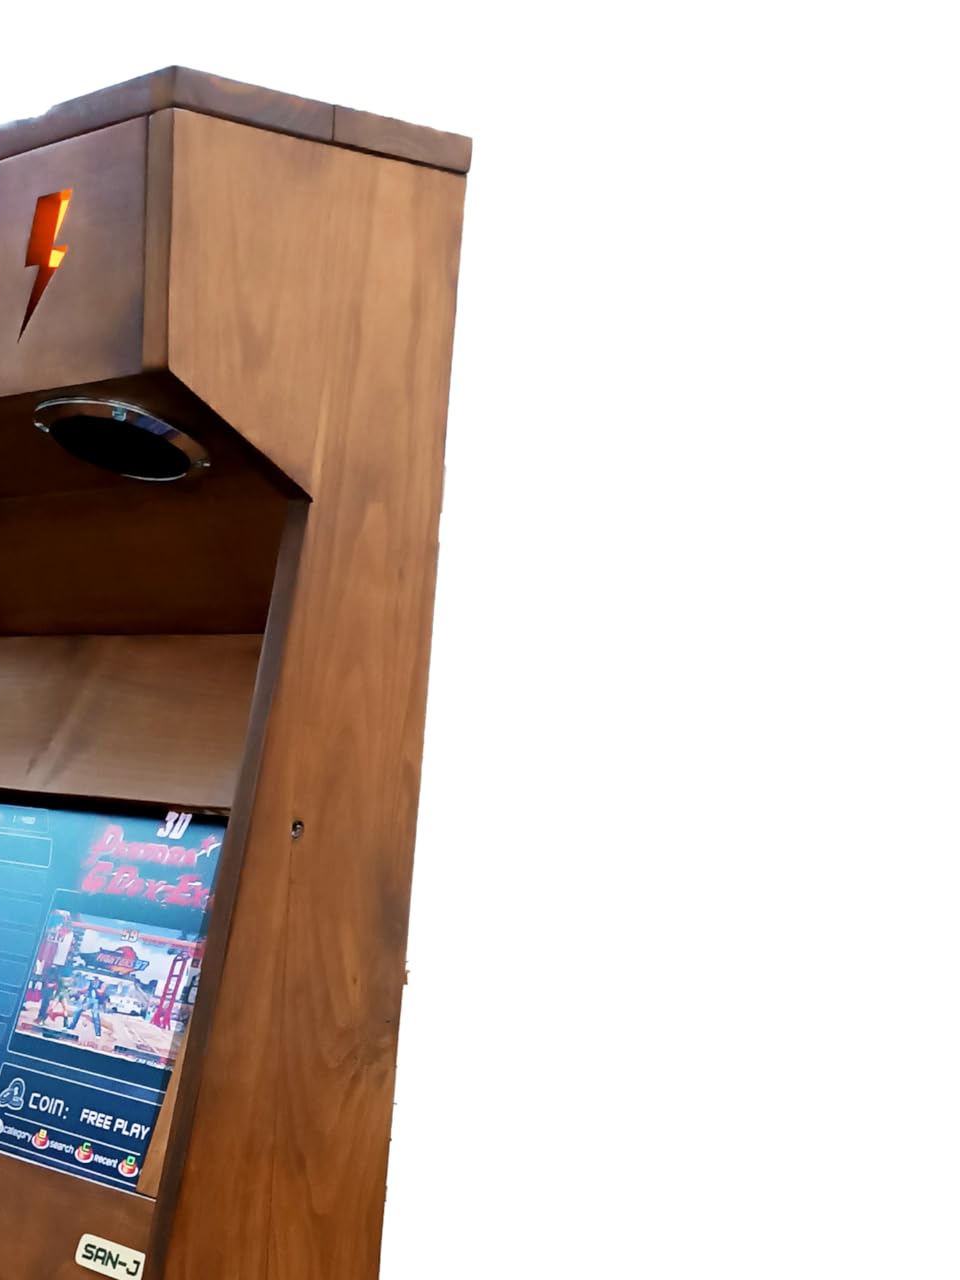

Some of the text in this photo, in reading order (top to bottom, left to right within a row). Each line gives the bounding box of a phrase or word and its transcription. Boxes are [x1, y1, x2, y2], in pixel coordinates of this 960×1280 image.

[156, 811, 193, 840] 3D
[28, 1092, 150, 1140] COIN: FREE PLAY
[2, 1125, 32, 1142] category
[48, 1140, 74, 1154] search
[82, 1243, 141, 1277] SAN-J
